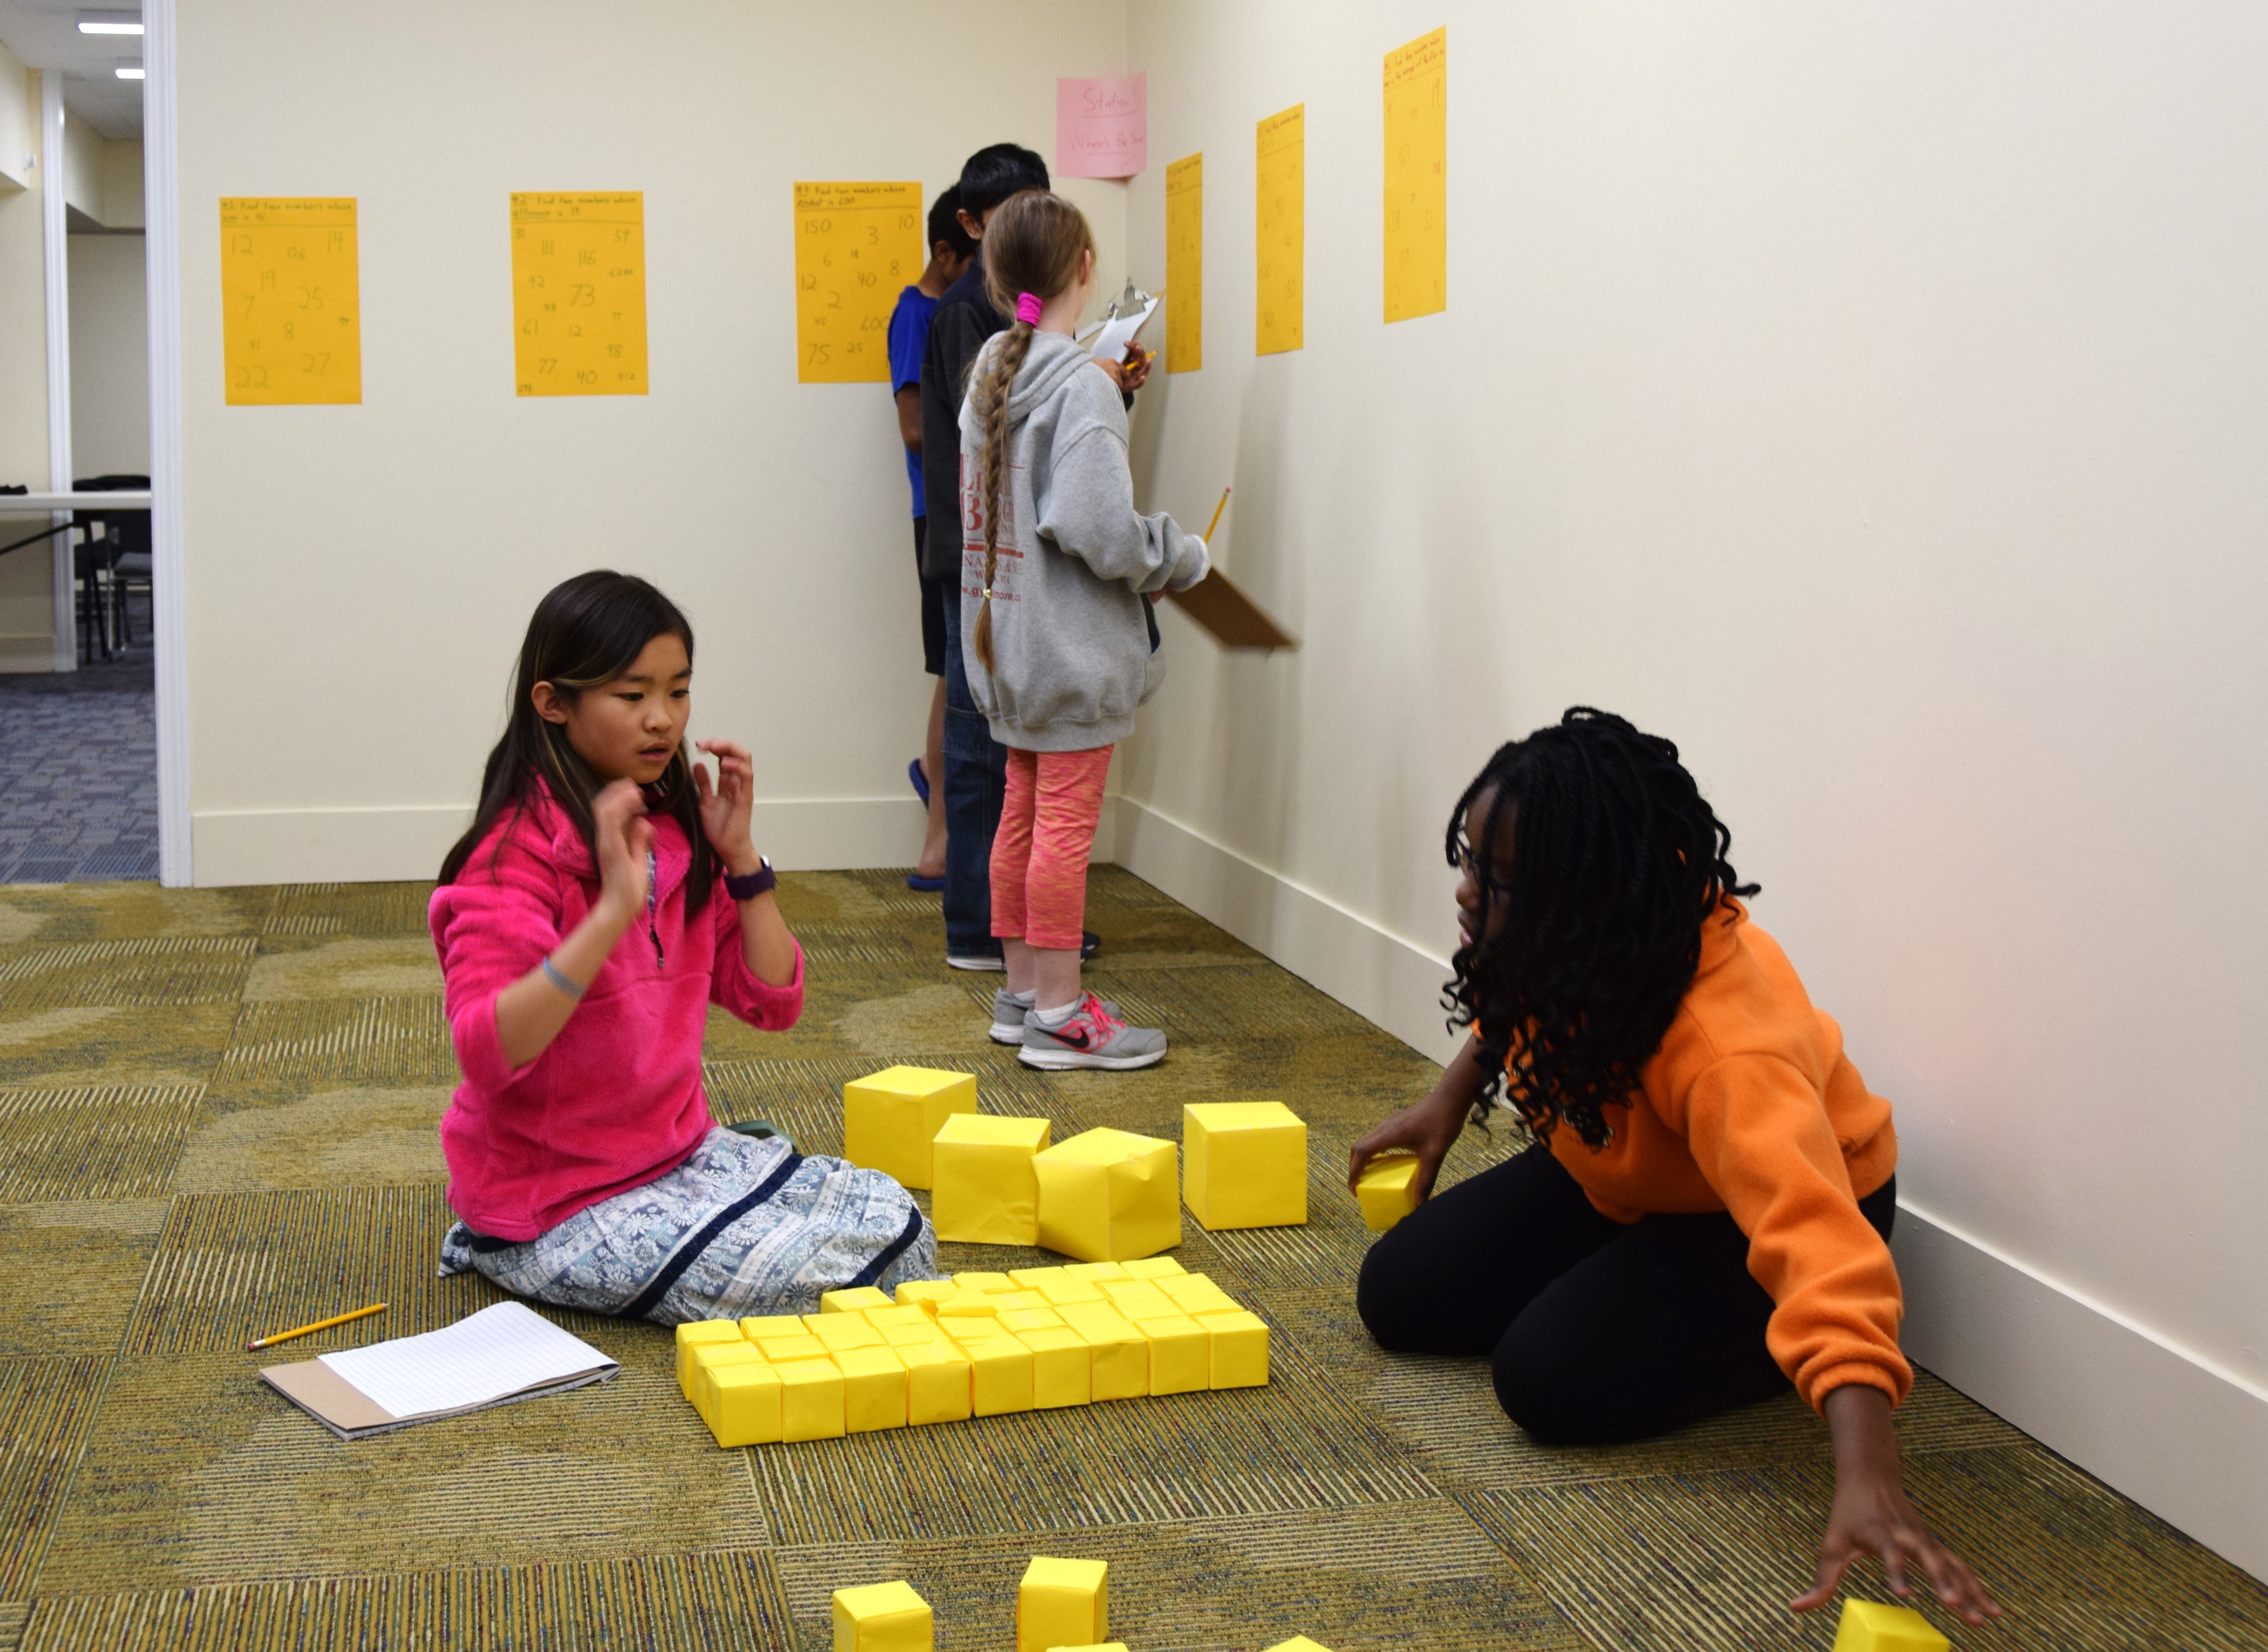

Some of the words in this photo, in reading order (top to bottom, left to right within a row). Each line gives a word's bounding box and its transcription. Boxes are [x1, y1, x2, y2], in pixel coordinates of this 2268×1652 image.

[805, 218, 832, 234] 150
[899, 214, 915, 231] 10
[232, 234, 253, 254] 12
[327, 230, 343, 252] 14
[867, 226, 879, 245] 3
[890, 259, 900, 277] 8
[801, 273, 817, 292] 12
[858, 271, 877, 287] 40
[298, 286, 324, 310] 25
[571, 283, 596, 308] 73
[827, 290, 842, 310] 2
[284, 321, 294, 340] 8
[301, 352, 331, 376] 27
[806, 343, 831, 366] 75
[235, 365, 271, 389] 22
[576, 369, 597, 385] 40
